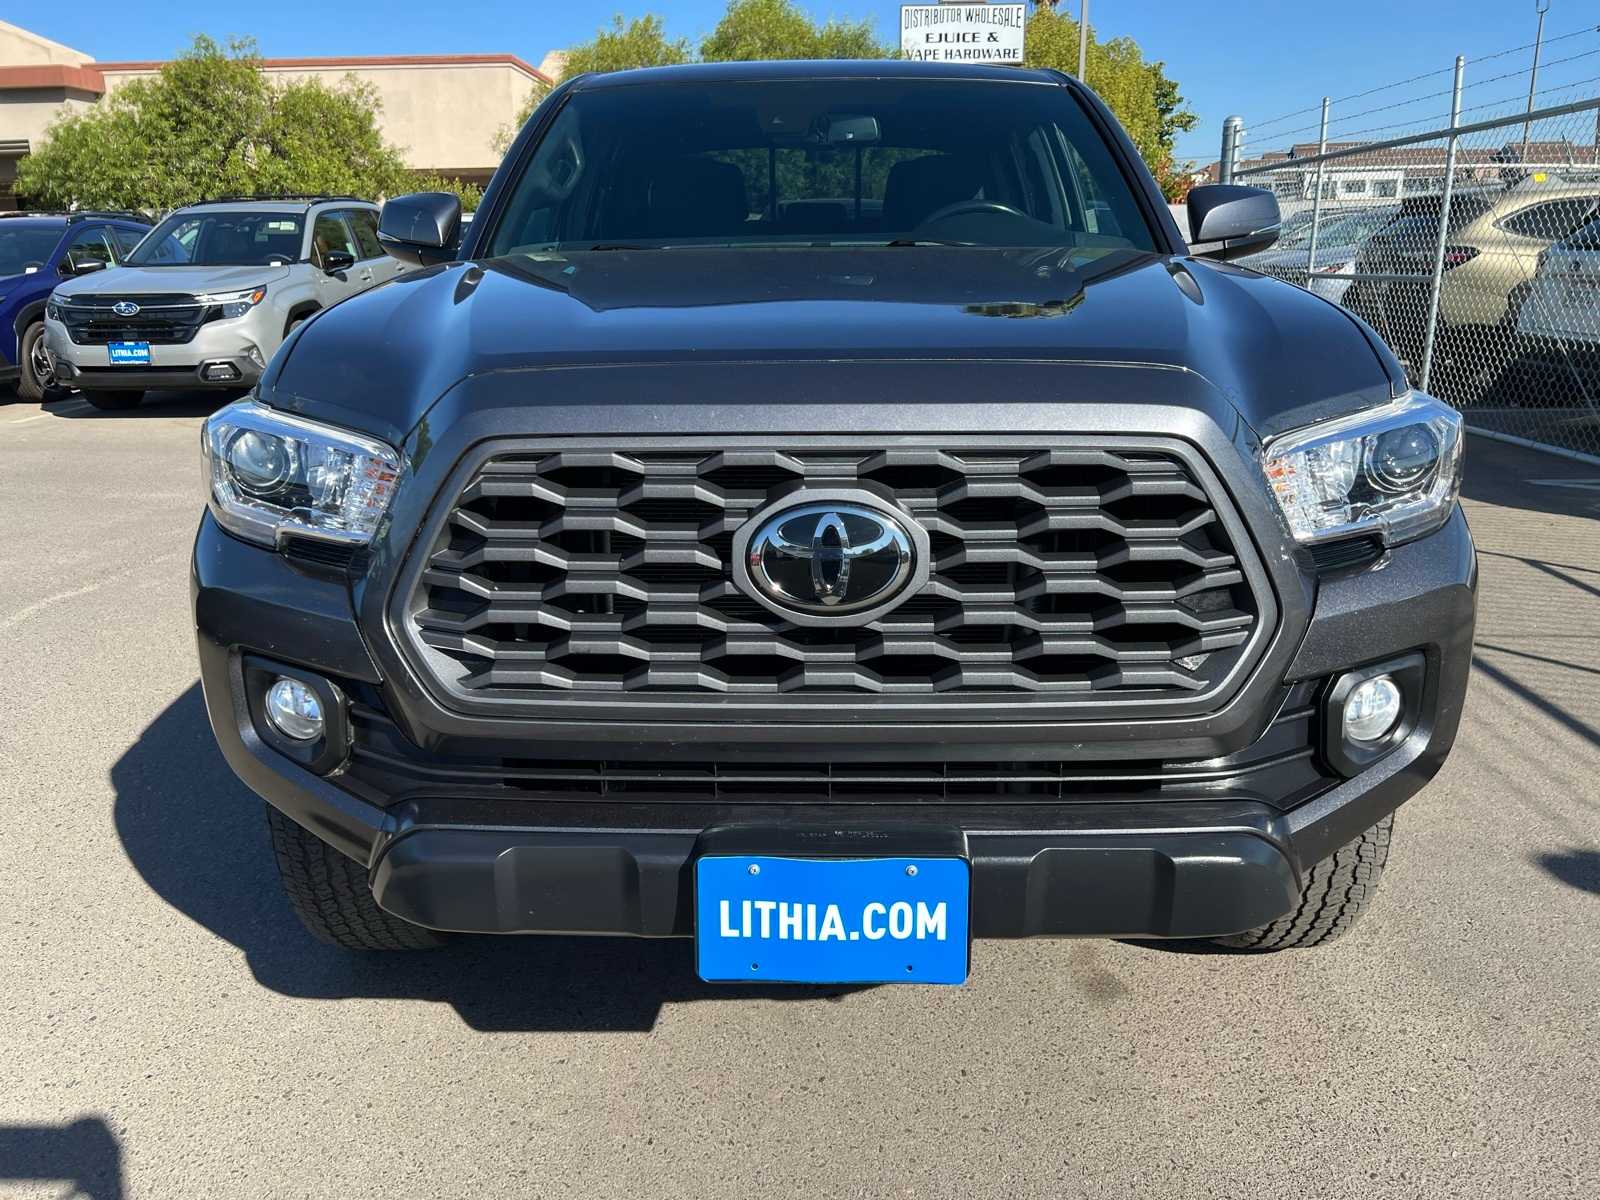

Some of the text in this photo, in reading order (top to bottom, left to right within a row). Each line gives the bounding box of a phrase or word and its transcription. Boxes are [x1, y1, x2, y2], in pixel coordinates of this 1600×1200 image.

[904, 7, 1022, 29] DISTRIBUTOR WHOLESALE
[925, 32, 1000, 43] EJUICE &
[905, 48, 1020, 60] VAPE HARDWARE
[719, 900, 948, 941] LITHIA.COM
